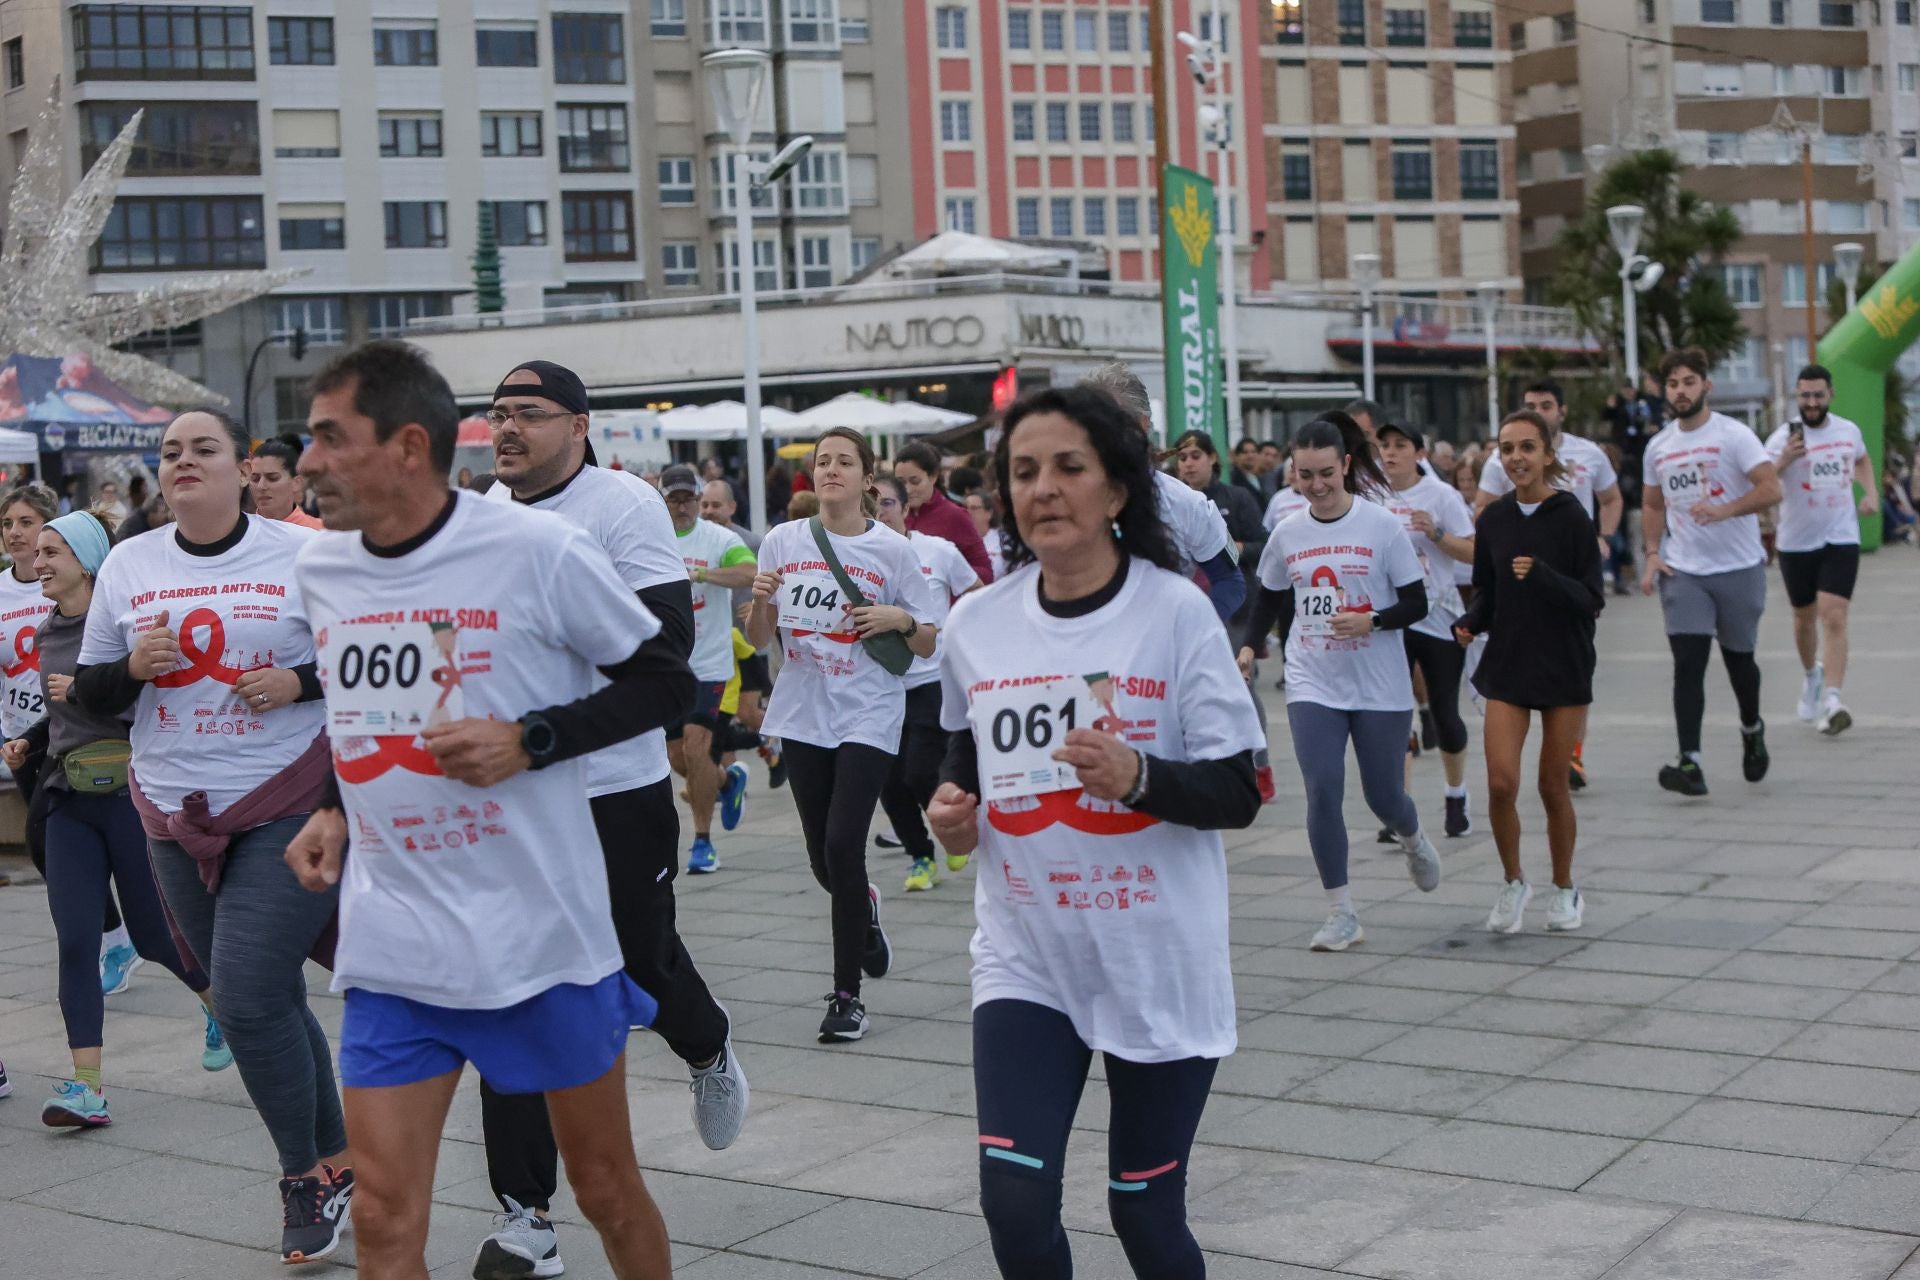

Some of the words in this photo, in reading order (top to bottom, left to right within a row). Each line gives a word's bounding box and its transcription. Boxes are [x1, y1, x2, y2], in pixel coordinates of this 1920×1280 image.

[1178, 278, 1206, 431] RURAL
[1813, 461, 1840, 476] 005
[1669, 472, 1698, 491] 004
[843, 564, 885, 588] ANTI-SIDA
[159, 585, 217, 600] CARRERA
[221, 583, 285, 597] ANTI-SIDA
[791, 584, 838, 611] 104
[2, 608, 35, 622] CARRERA
[1302, 595, 1332, 615] 128
[254, 613, 278, 621] LORENZO
[411, 608, 498, 630] ANTI-SIDA
[339, 643, 421, 689] 060
[9, 688, 44, 713] 152
[992, 697, 1076, 753] 061
